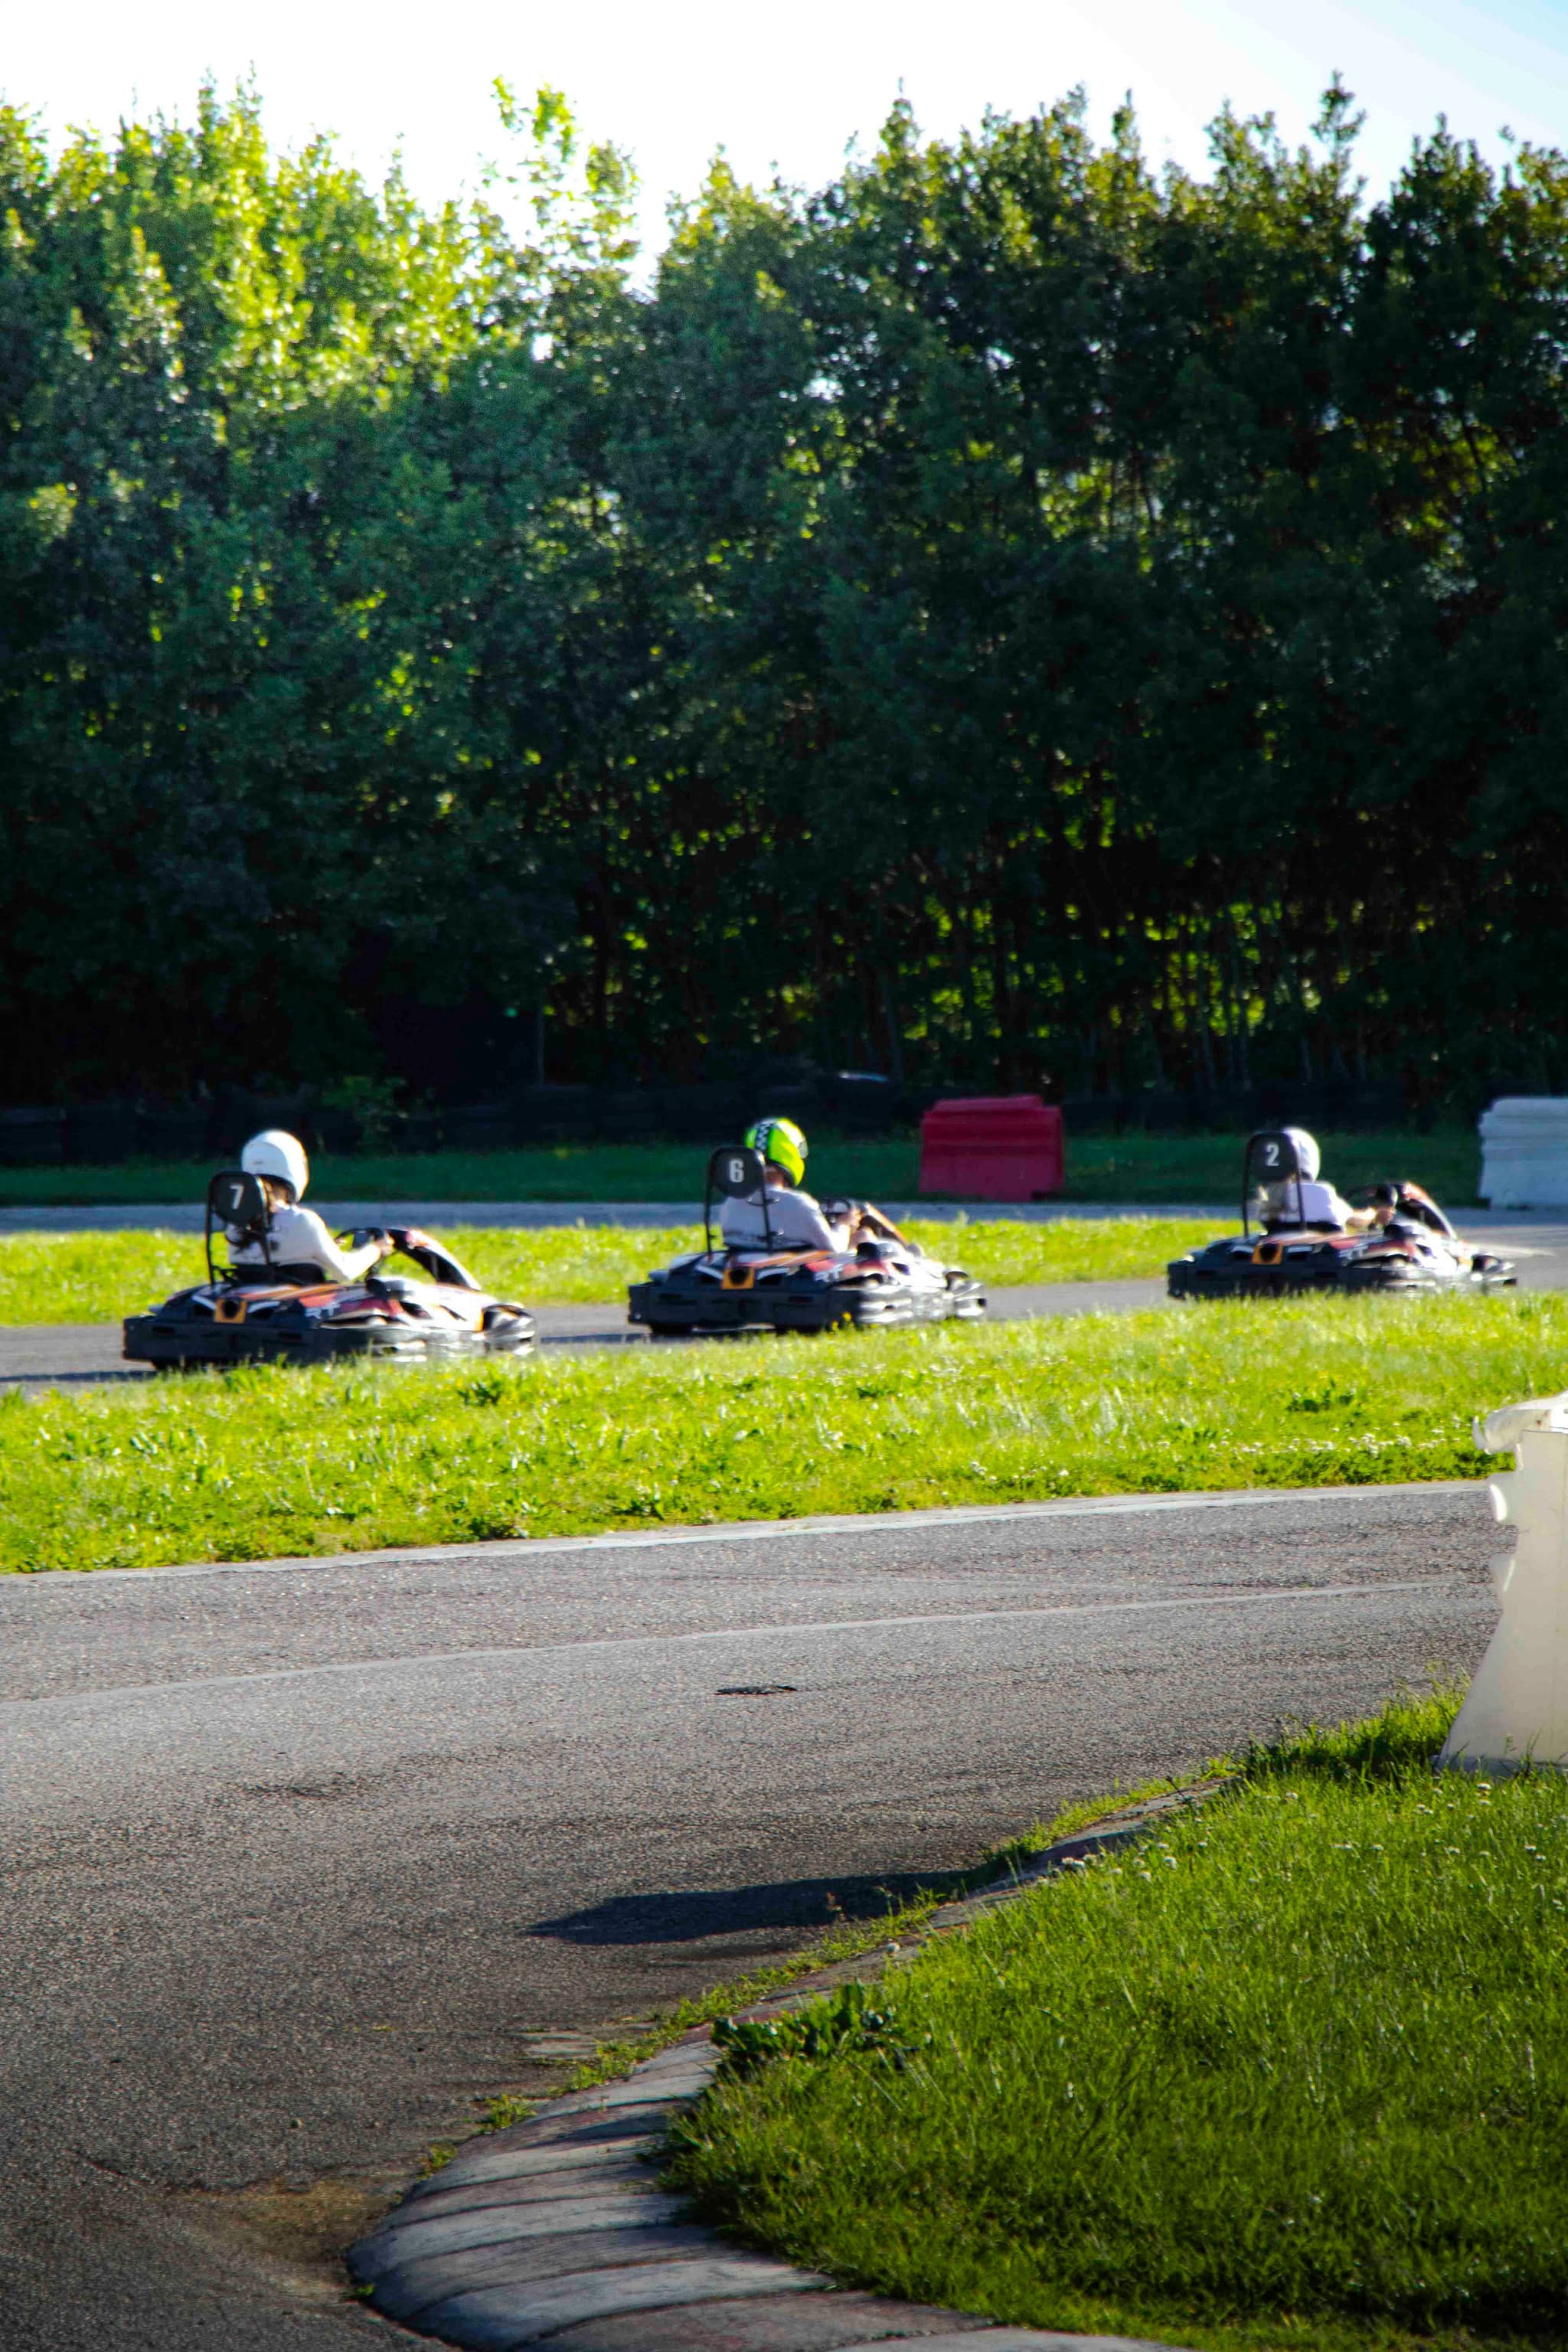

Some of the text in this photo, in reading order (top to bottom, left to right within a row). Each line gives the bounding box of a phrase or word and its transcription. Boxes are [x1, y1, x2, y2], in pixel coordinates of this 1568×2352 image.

[1266, 1143, 1279, 1167] 2
[730, 1158, 744, 1183] 6
[230, 1184, 244, 1210] 7
